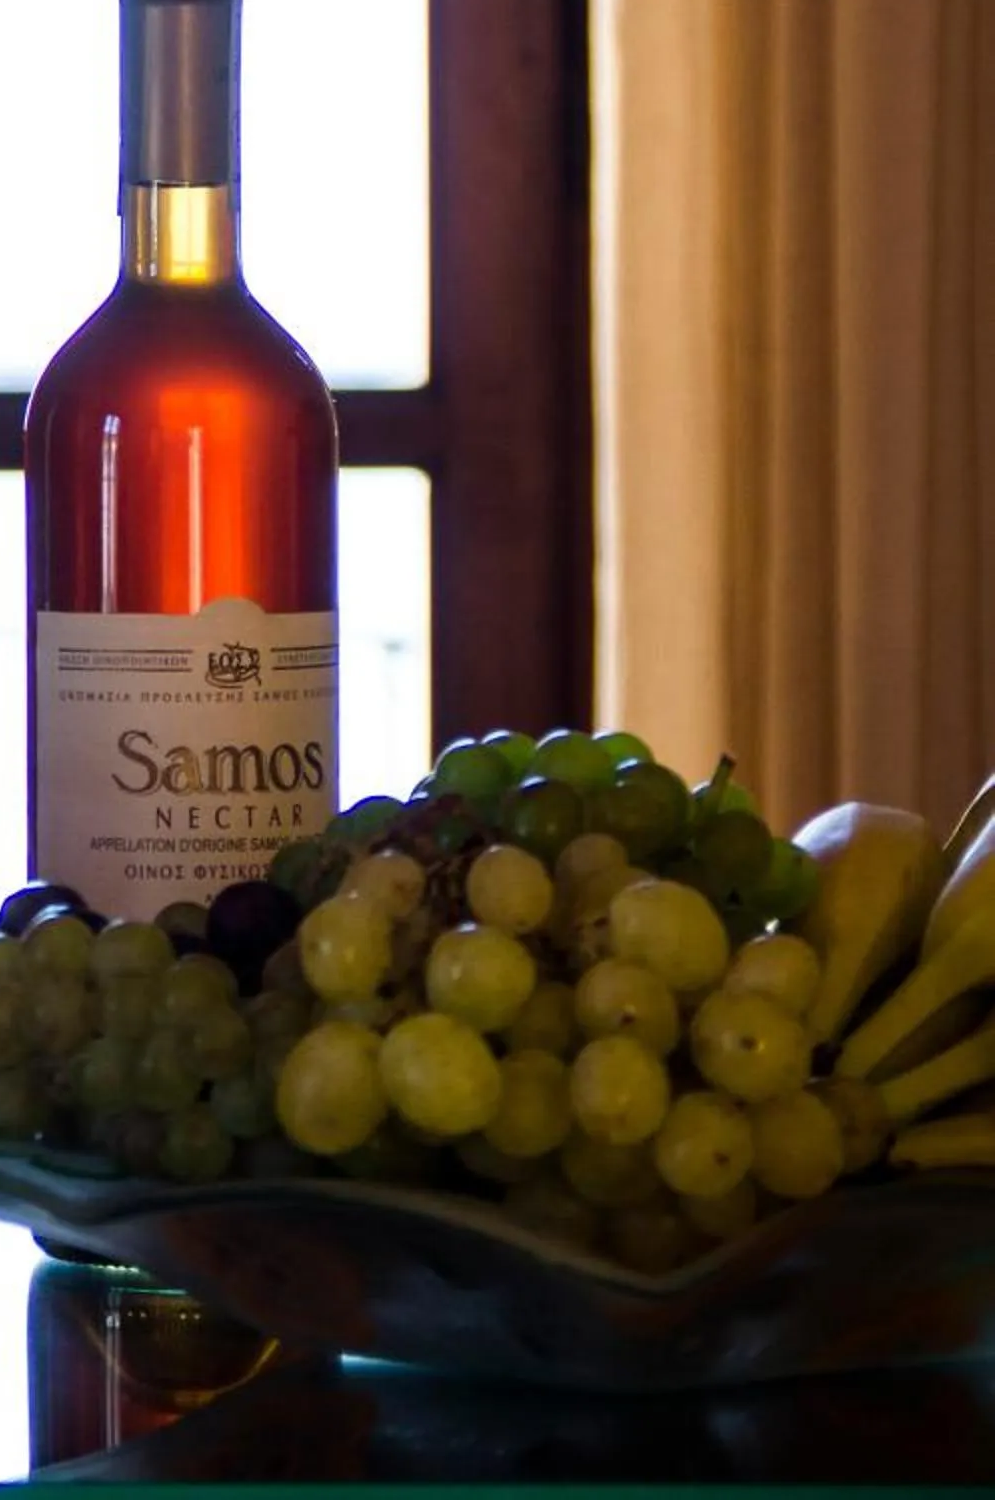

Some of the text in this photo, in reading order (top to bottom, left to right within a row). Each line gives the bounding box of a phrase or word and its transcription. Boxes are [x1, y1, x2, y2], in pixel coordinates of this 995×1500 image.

[111, 729, 324, 796] Samos
[156, 803, 303, 829] NECTAR
[90, 836, 175, 853] APPELLATION
[179, 836, 247, 852] D'ORIGINE
[124, 864, 185, 880] ΟΙΝΟΣ
